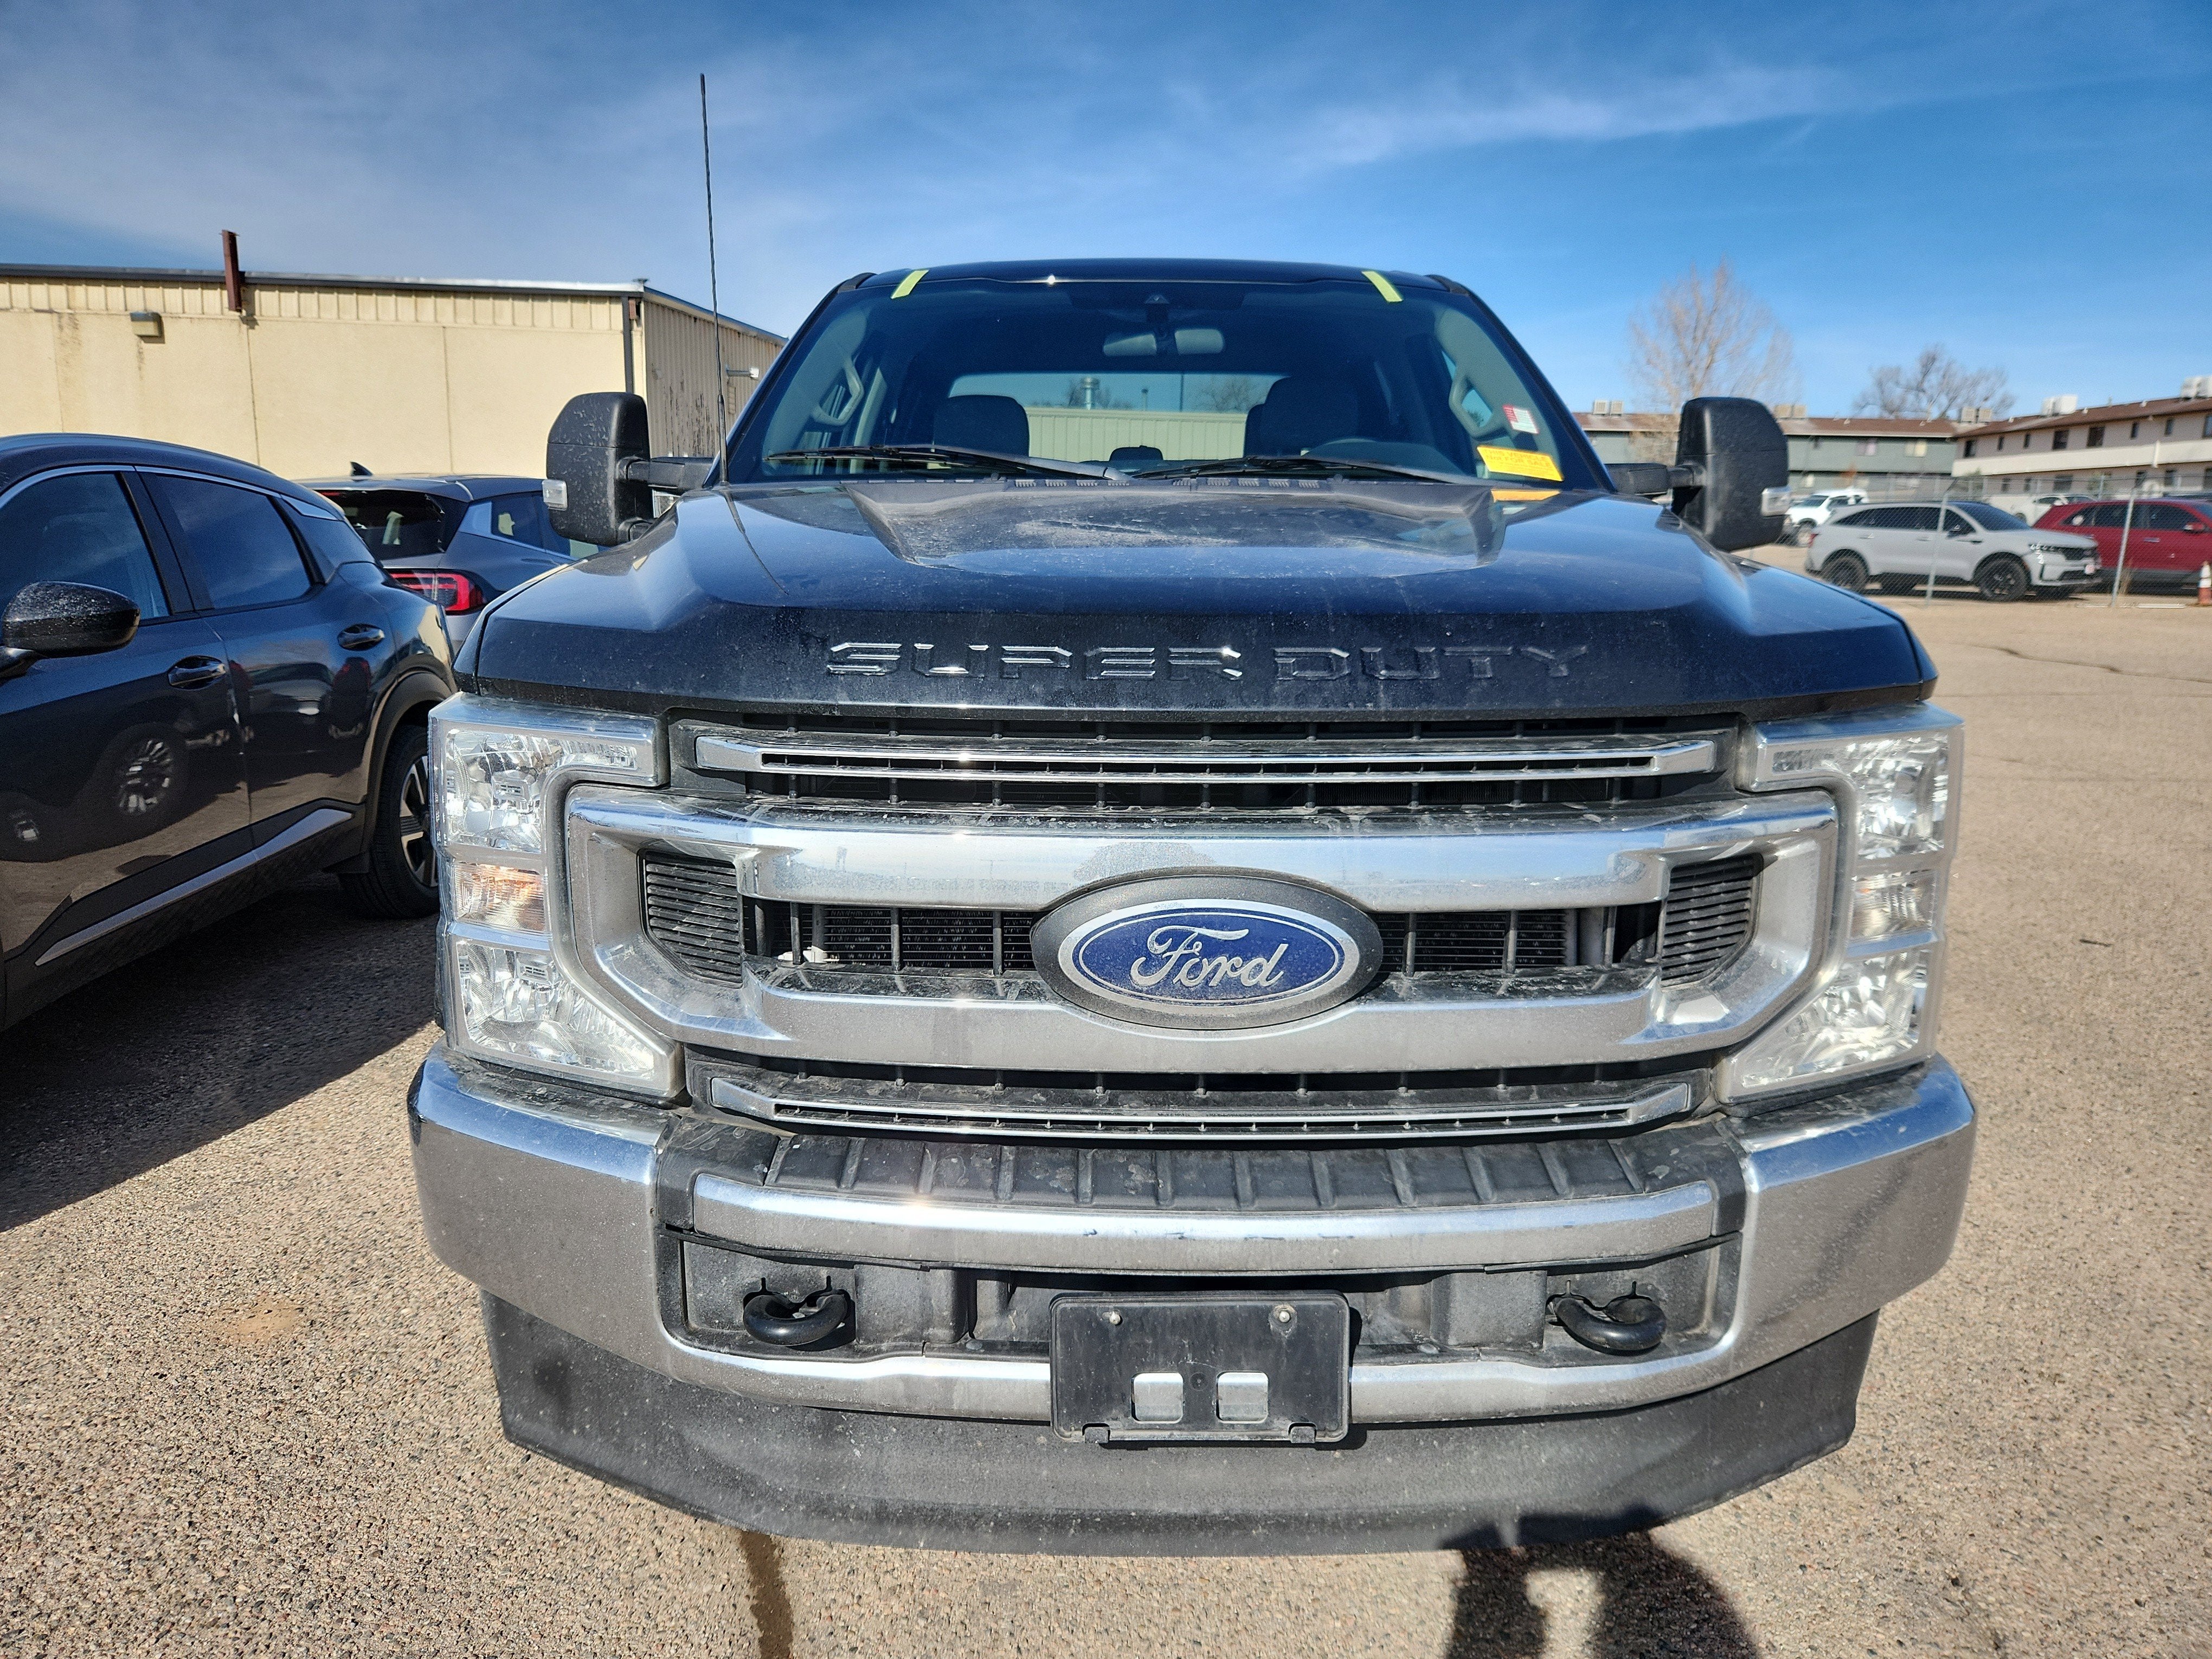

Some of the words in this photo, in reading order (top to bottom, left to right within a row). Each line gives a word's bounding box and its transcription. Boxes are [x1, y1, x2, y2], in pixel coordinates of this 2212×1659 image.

[1504, 456, 1525, 464] FOR
[1528, 459, 1553, 468] SALE
[1507, 451, 1547, 462] VEHICLE
[826, 642, 1243, 681] SUPER
[1274, 646, 1588, 681] DUTY
[1130, 925, 1289, 988] Ford
